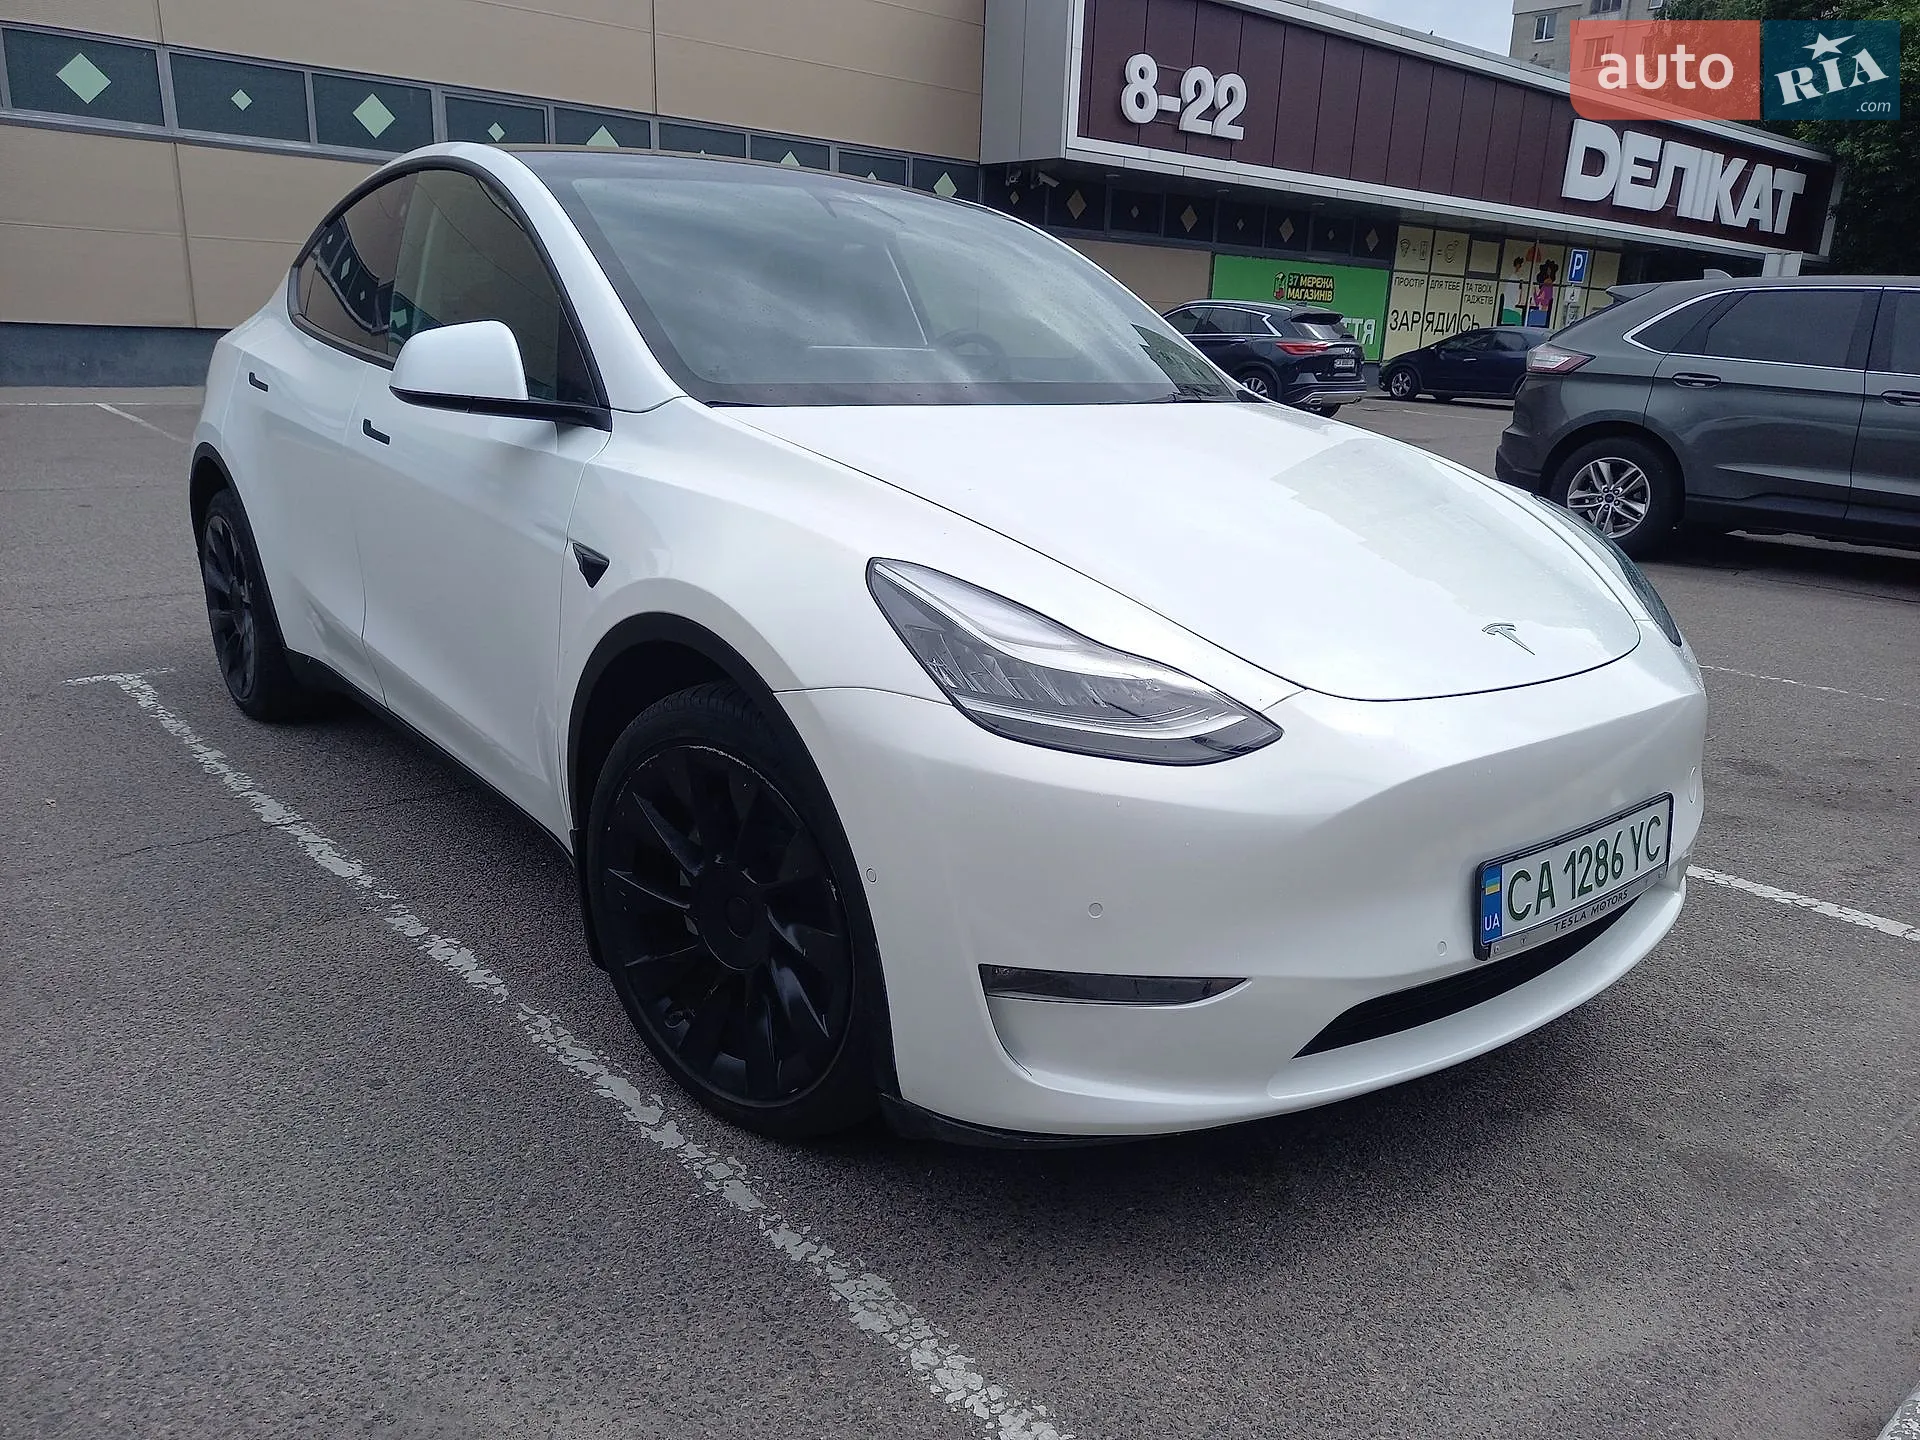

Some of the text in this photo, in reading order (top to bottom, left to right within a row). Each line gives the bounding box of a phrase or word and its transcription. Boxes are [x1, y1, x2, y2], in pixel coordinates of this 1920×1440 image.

[1120, 53, 1247, 141] 8-22
[1571, 253, 1583, 279] P
[1288, 274, 1334, 289] 37 МЕРЕЖА
[1394, 276, 1425, 288] ПРОСТІР
[1429, 279, 1443, 290] ДЛЯ
[1444, 281, 1461, 291] ТЕБЕ
[1465, 282, 1474, 292] ТА
[1287, 287, 1333, 302] МАГАЗИНІВ
[1464, 294, 1494, 305] ГАДЖЕТІВ
[1507, 815, 1662, 921] CA 1286 YC
[1554, 890, 1628, 932] TESLA MOTORS
[1484, 913, 1500, 931] UA
